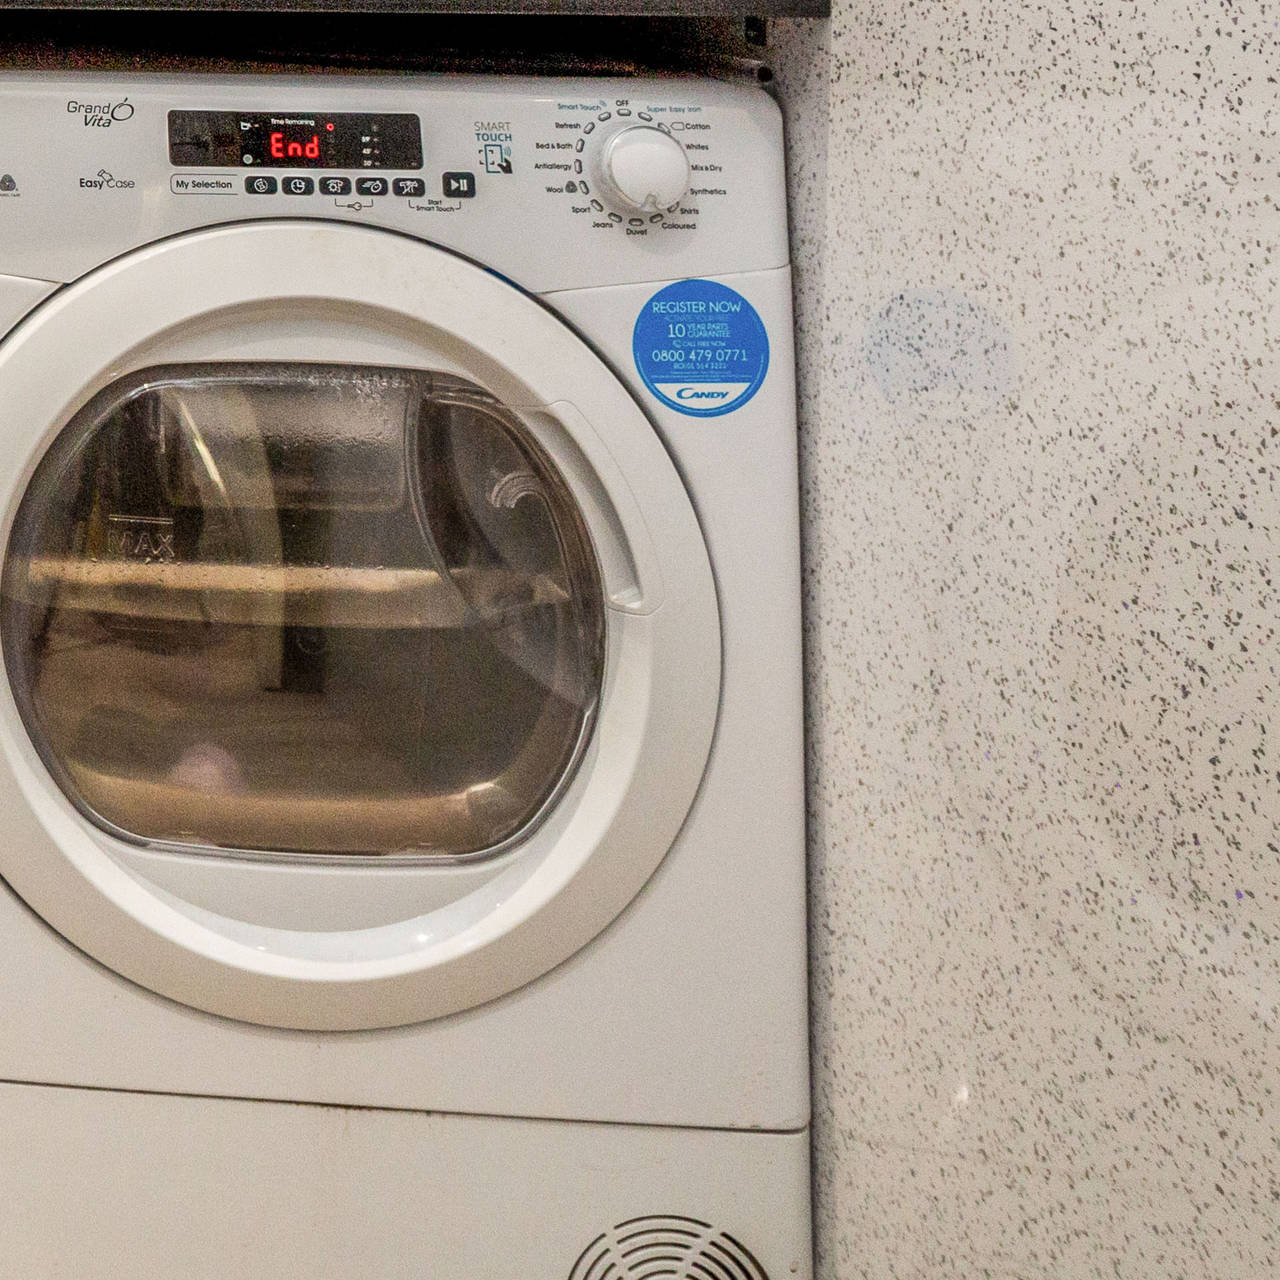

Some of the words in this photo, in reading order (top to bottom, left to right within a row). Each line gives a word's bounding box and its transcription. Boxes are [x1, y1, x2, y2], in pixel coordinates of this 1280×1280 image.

[557, 103, 578, 111] Smart
[646, 106, 667, 114] Super
[84, 114, 112, 128] Vita
[474, 121, 511, 131] SMART
[475, 132, 512, 142] TOUCH
[270, 132, 320, 158] End
[534, 163, 572, 171] Antiallergy
[80, 178, 104, 190] Easy
[176, 180, 189, 189] My
[191, 180, 233, 189] Selection
[571, 206, 591, 214] Sport
[626, 228, 647, 236] Duvet
[652, 301, 706, 314] REGISTER
[709, 301, 742, 313] NOW
[668, 323, 686, 338] 10
[652, 350, 685, 362] 0800
[689, 350, 712, 362] 479
[715, 349, 747, 361] 0771
